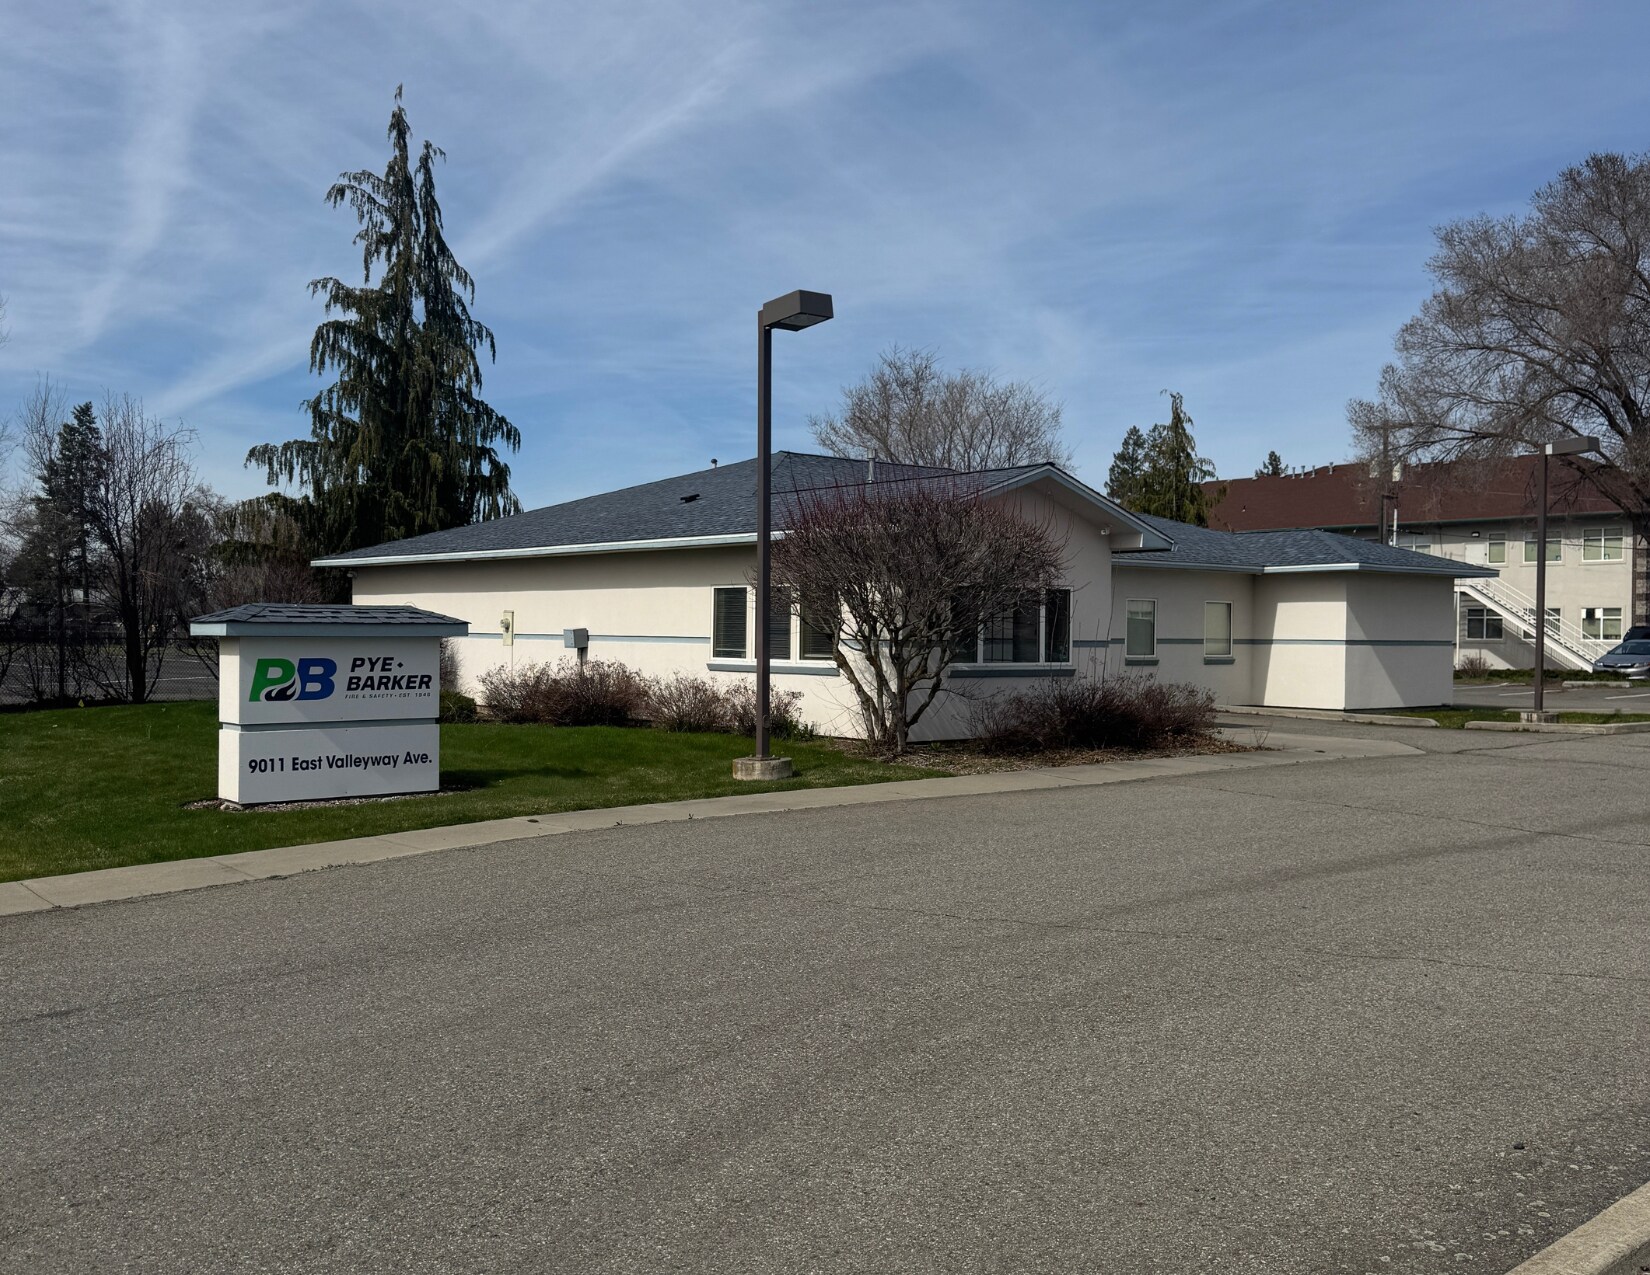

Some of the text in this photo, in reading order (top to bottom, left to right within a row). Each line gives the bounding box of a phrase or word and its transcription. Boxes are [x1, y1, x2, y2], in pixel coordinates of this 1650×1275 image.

[350, 657, 394, 672] PYE
[346, 675, 432, 691] BARKER
[248, 751, 433, 773] 9011 East Valleyway Ave.
